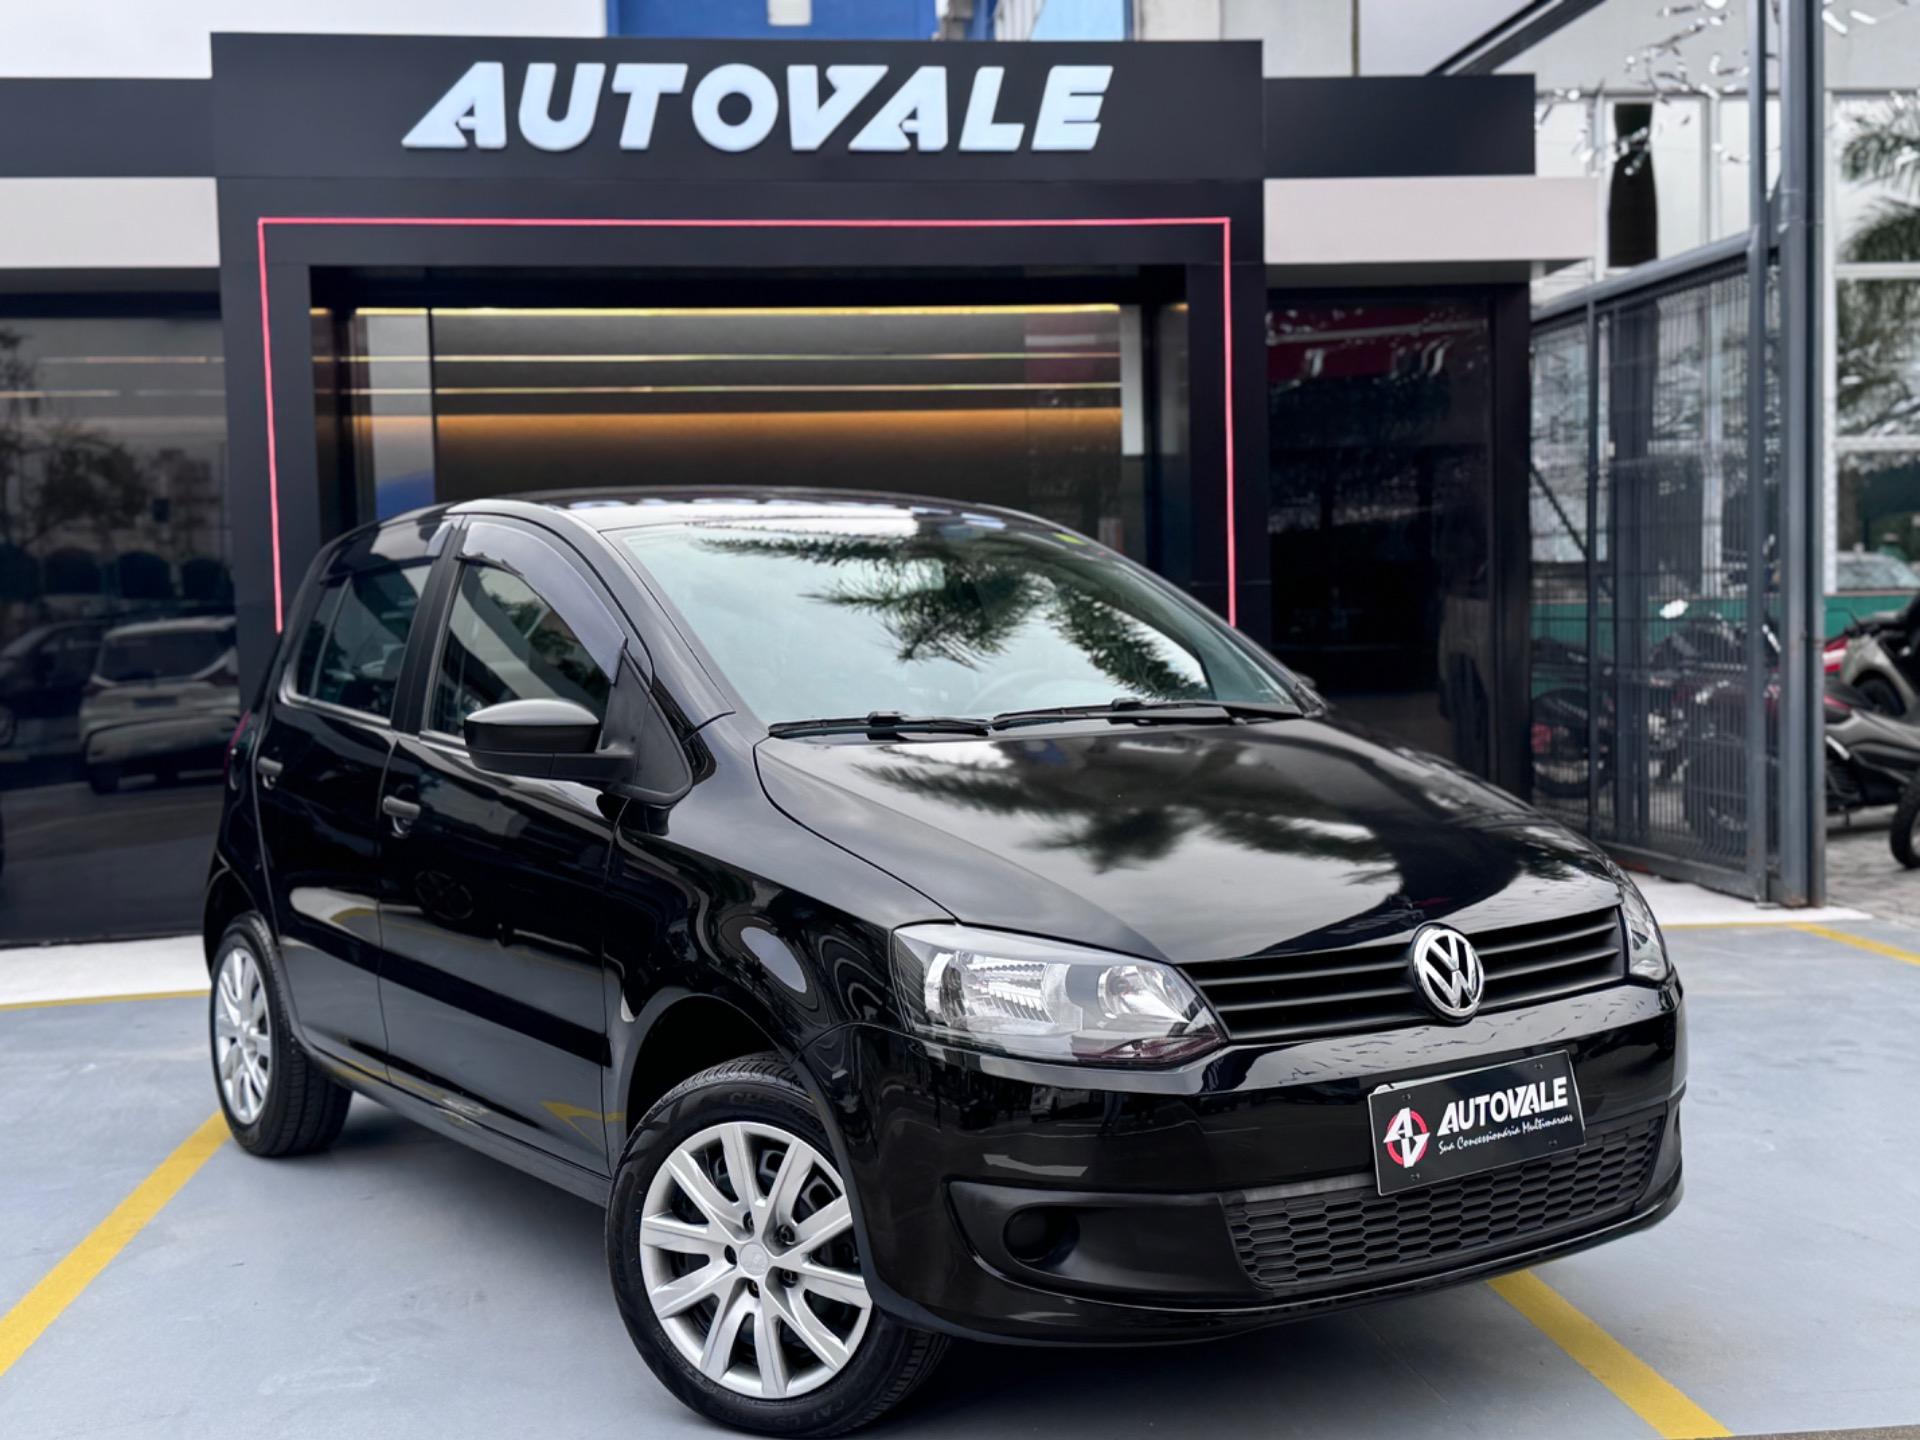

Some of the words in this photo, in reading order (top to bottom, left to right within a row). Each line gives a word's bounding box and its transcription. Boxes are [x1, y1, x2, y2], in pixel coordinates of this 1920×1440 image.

[401, 61, 1114, 153] AUTOVALE
[1414, 927, 1485, 1018] VW
[1436, 1076, 1569, 1137] AUTOVALE
[1438, 1140, 1456, 1156] Sua
[1456, 1125, 1521, 1151] Concessionária
[1522, 1113, 1574, 1135] Multimarcas
